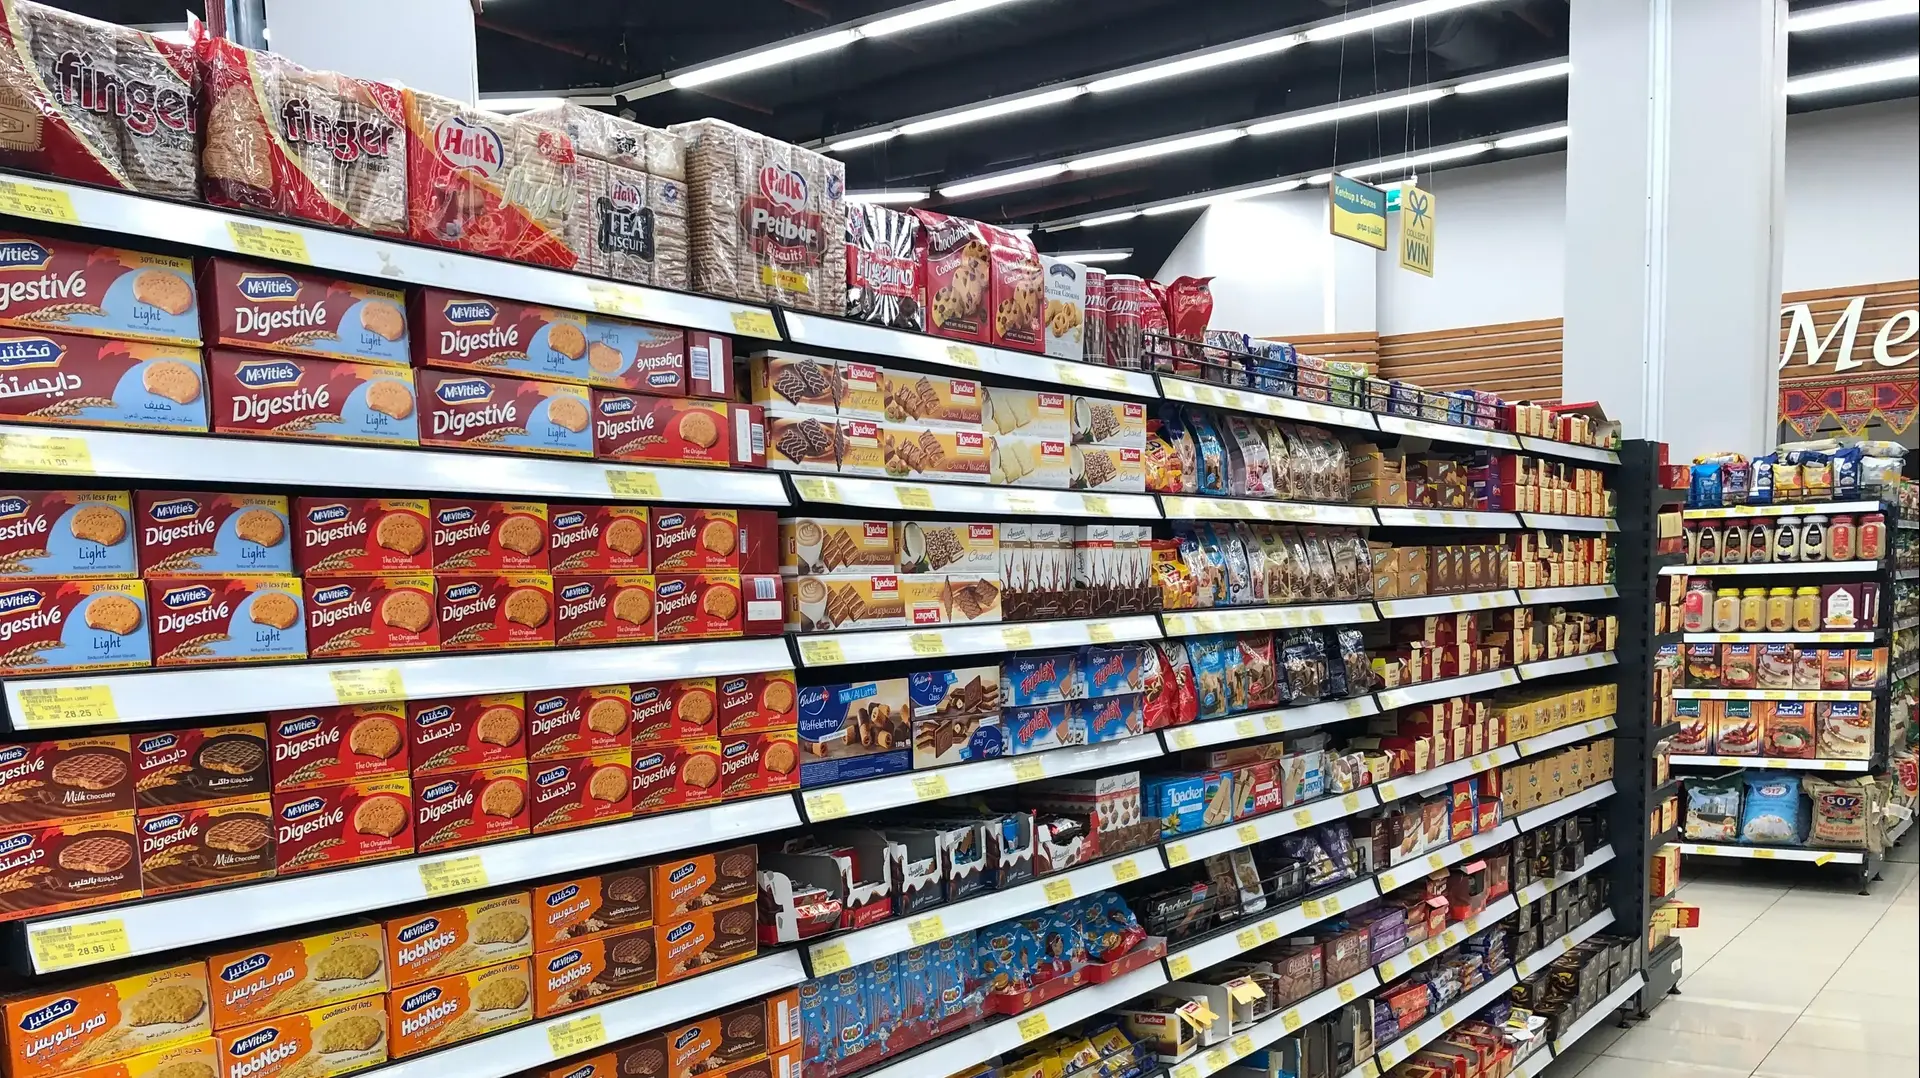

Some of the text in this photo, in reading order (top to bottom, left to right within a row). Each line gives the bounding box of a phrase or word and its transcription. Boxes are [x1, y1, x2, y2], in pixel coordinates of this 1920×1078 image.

[54, 50, 197, 136] finger
[281, 99, 396, 161] finger
[444, 127, 497, 165] Halk
[612, 186, 638, 205] Halk
[1335, 185, 1354, 203] Ketchup
[1360, 195, 1376, 209] Sauces
[607, 209, 644, 239] TEA
[752, 208, 816, 243] Petibör
[608, 233, 645, 252] BISCUIT
[1407, 228, 1425, 240] COLLECT
[767, 242, 803, 263] Biscuits
[1406, 239, 1428, 266] WIN
[936, 258, 961, 276] Cookies
[0, 270, 86, 310] gestive
[248, 280, 292, 293] McVitie's
[133, 306, 160, 326] Light
[235, 301, 326, 336] Digestive
[451, 306, 490, 319] McVitie's
[440, 324, 518, 357] Digestive
[1779, 296, 1919, 371] Me
[361, 335, 381, 351] Light
[546, 353, 565, 366] Light
[637, 352, 683, 371] Digestive
[246, 366, 293, 381] McVitie's
[849, 364, 875, 381] Loacker
[443, 384, 486, 398] McVitie's
[952, 381, 974, 395] Loacker
[232, 384, 330, 423] Digestive
[604, 400, 631, 413] McVitie's
[1039, 394, 1063, 406] Loacker
[433, 400, 517, 436] Digestive
[1124, 405, 1141, 416] Loacker
[366, 413, 388, 431] Light
[597, 412, 654, 440] Digestive
[850, 422, 876, 438] Loacker
[548, 427, 566, 443] Light
[957, 433, 982, 448] Loacker
[1042, 442, 1063, 453] Loacker
[1120, 449, 1139, 459] Loacker
[156, 504, 193, 518] McVitie's
[313, 508, 344, 522] McVitie's
[442, 511, 471, 522] McVitie's
[0, 514, 47, 540] estive
[145, 516, 215, 546] Digestive
[305, 518, 367, 547] Digestive
[435, 520, 491, 546] Digestive
[864, 522, 887, 537] Loacker
[969, 525, 992, 538] Loacker
[79, 548, 107, 566] Light
[241, 547, 266, 565] Light
[120, 582, 131, 591] fat
[450, 586, 477, 599] McVitie's
[169, 590, 206, 606] McVitie's
[312, 597, 372, 628] Digestive
[443, 595, 496, 622] Digestive
[158, 602, 229, 634] Digestive
[94, 638, 121, 657] Light
[256, 631, 280, 648] Light
[860, 686, 876, 698] Latte
[64, 709, 92, 718] 28.25
[800, 717, 839, 732] Waffeletten
[62, 791, 116, 805] Milk Chocolate
[1167, 787, 1204, 806] Loacker
[1256, 788, 1281, 806] Loacker
[1826, 795, 1856, 807] 507
[213, 854, 233, 867] Milk
[451, 877, 470, 887] 28.95
[476, 902, 501, 914] Goodness
[502, 899, 508, 908] of
[78, 945, 105, 956] 28.95
[399, 929, 456, 967] HobNobs
[478, 969, 501, 981] Goodness
[548, 963, 592, 992] HobNobs
[322, 1007, 350, 1021] Goodness
[401, 999, 458, 1036] HobNobs
[231, 1040, 298, 1078] HobNobs
